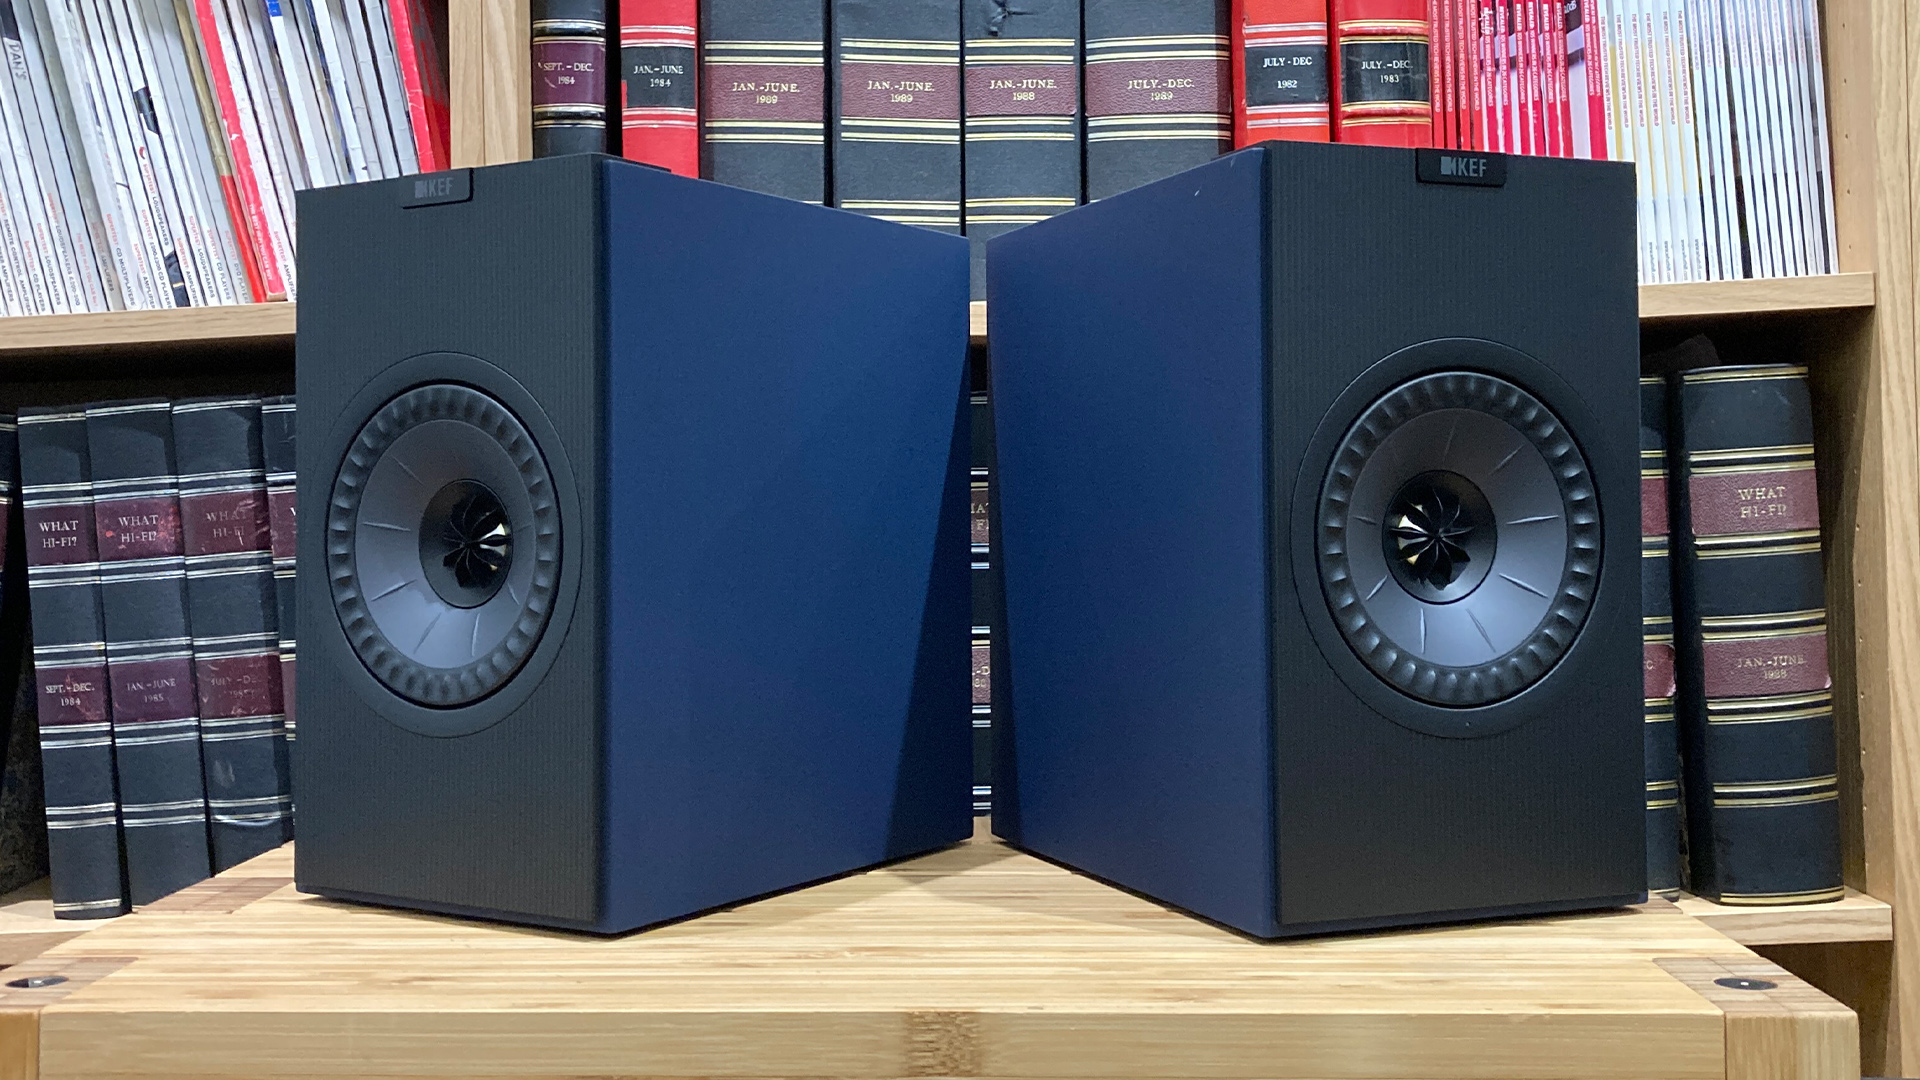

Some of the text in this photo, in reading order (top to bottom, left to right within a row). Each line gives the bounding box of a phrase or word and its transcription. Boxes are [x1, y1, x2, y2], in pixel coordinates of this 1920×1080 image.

[8, 43, 27, 81] DAN'S
[558, 76, 575, 85] 1984
[650, 78, 671, 87] 1984
[1277, 80, 1297, 89] 1982
[1380, 74, 1399, 83] 1983
[891, 93, 913, 103] 1989
[1013, 92, 1035, 101] 1988
[1151, 91, 1174, 101] 1989
[1458, 156, 1487, 178] KEF
[428, 177, 453, 198] KEF
[1738, 486, 1786, 500] WHAT
[118, 514, 159, 527] WHAT
[206, 508, 248, 521] WHAT
[39, 520, 79, 532] WHAT
[43, 536, 77, 549] HI-FI?
[121, 531, 157, 543] HI-FI?
[60, 698, 81, 706] 1984
